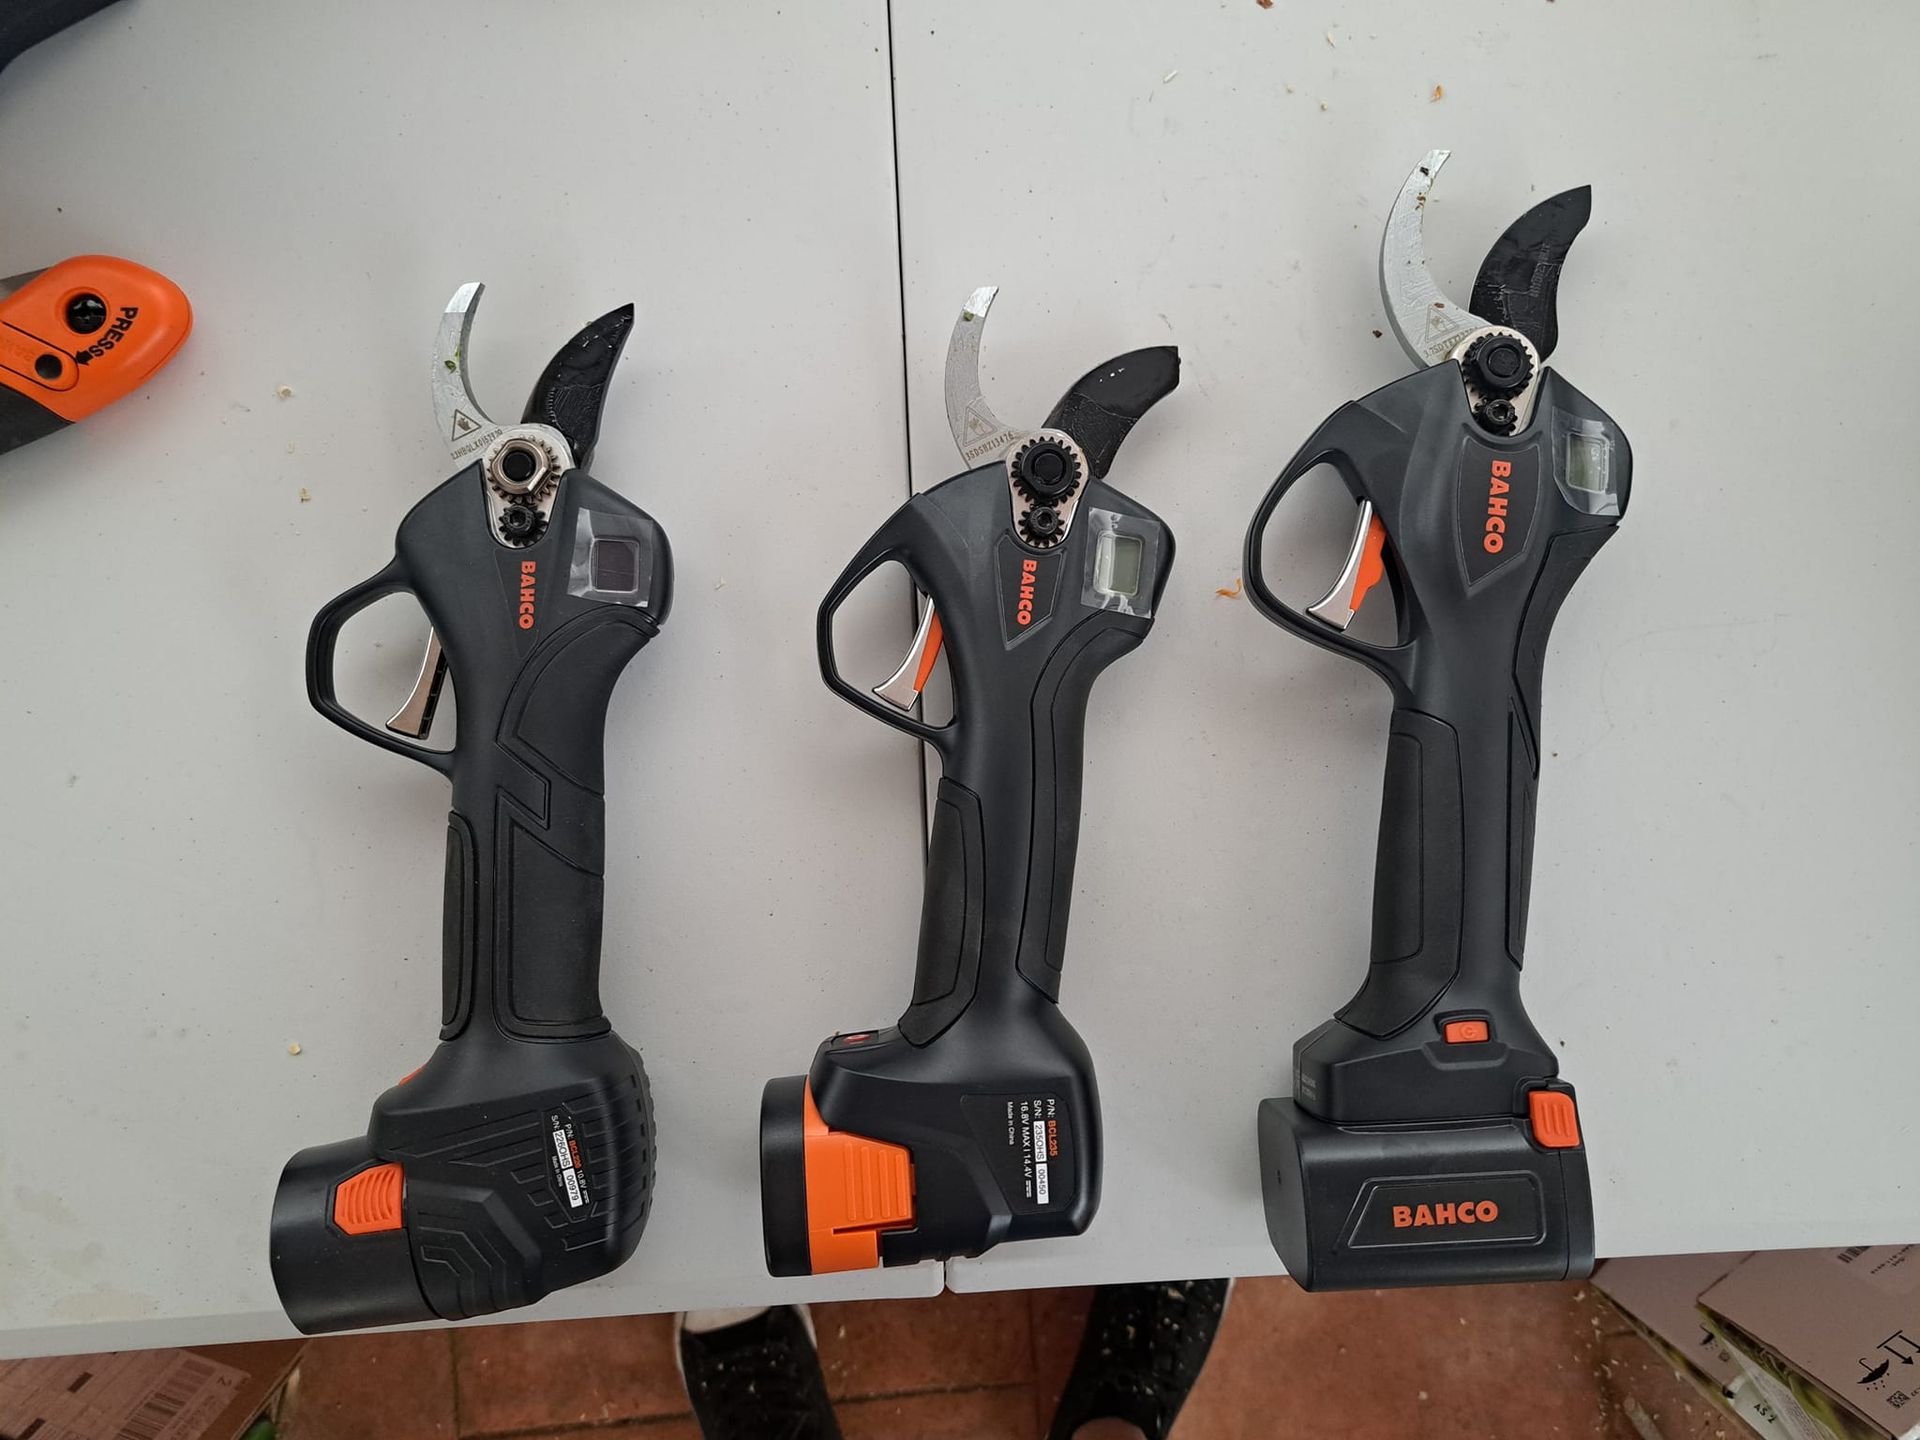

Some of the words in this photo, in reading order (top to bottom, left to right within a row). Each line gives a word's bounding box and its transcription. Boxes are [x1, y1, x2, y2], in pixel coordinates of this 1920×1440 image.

[88, 306, 139, 357] PRESS
[1483, 460, 1512, 554] BAHCO
[519, 560, 536, 629] BAHCO
[1017, 559, 1037, 625] BAHCO
[1022, 1127, 1031, 1148] MAX
[1048, 1120, 1058, 1156] BCL235
[566, 1174, 580, 1201] 00979
[1038, 1168, 1047, 1195] 00450
[1392, 1200, 1498, 1227] BAHCO
